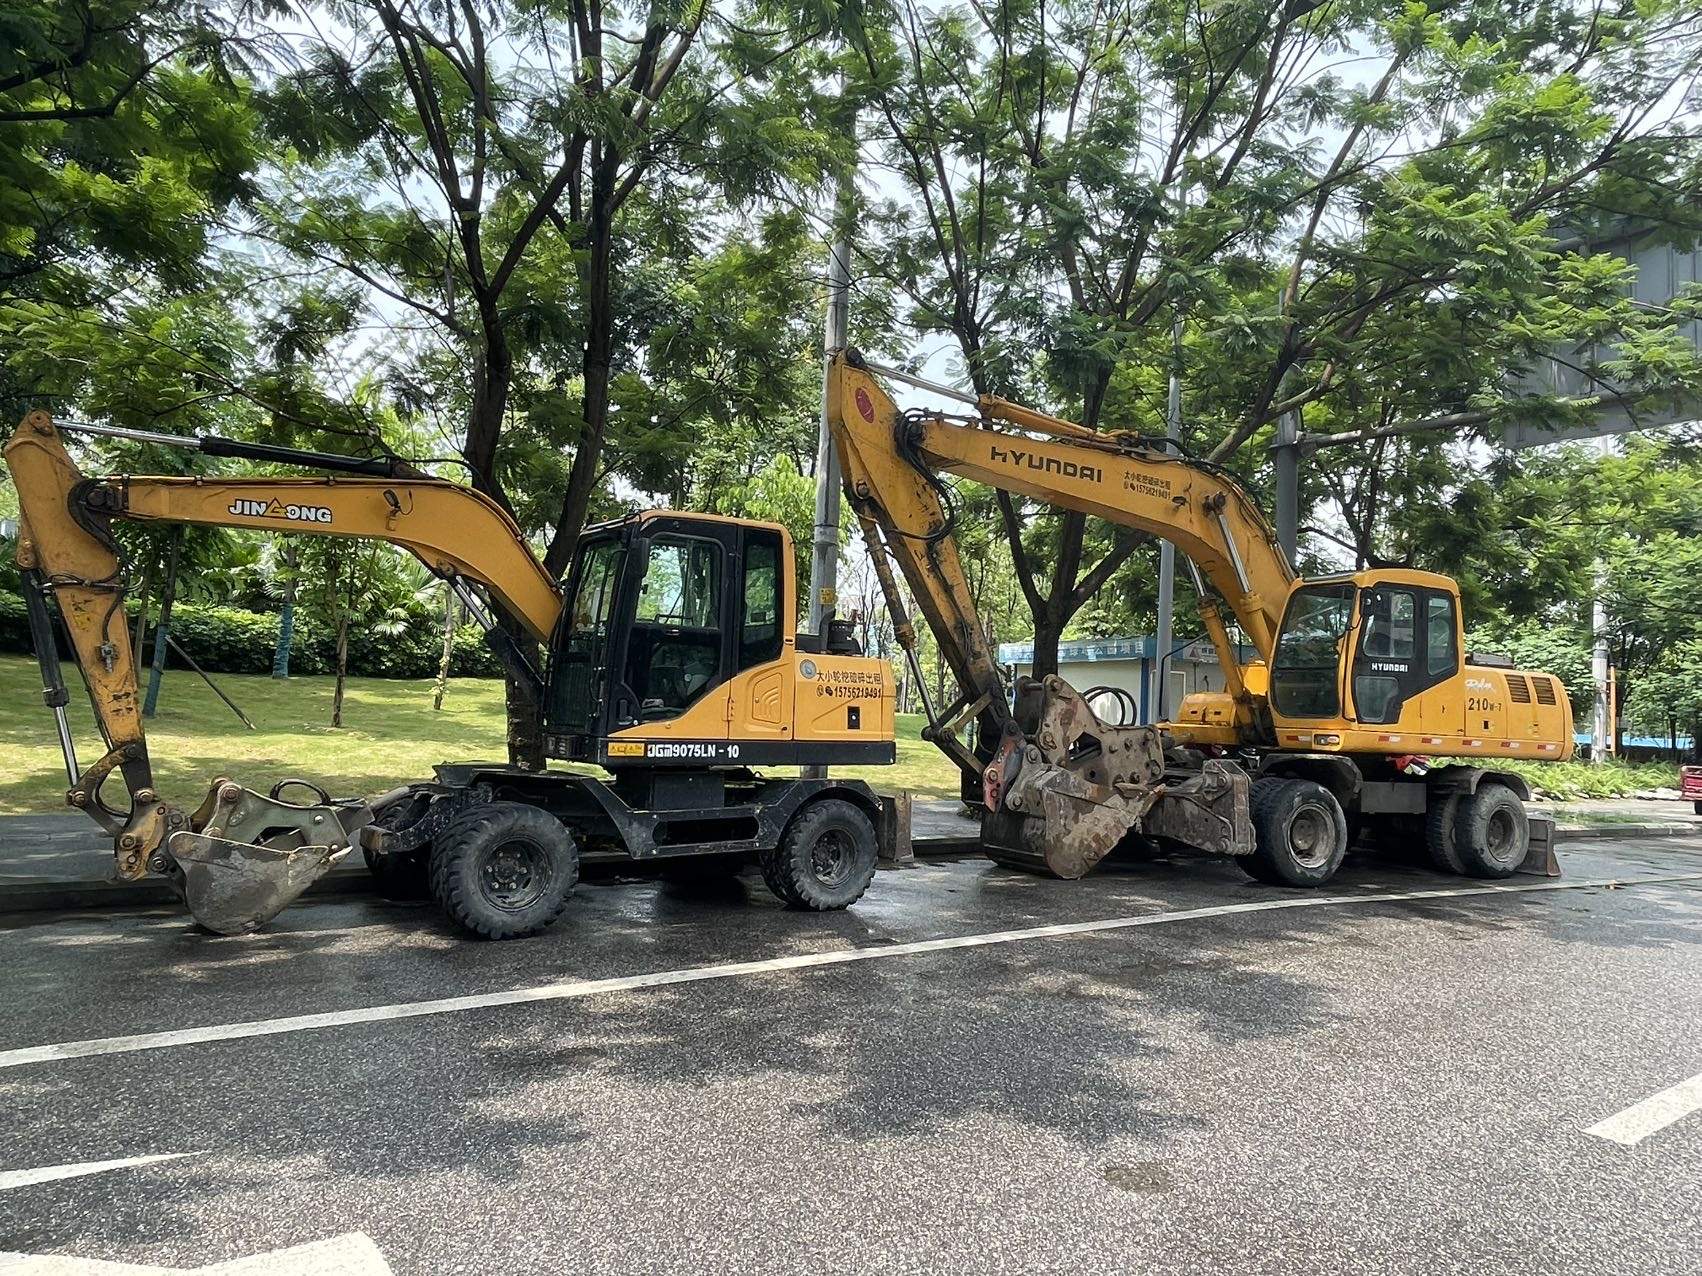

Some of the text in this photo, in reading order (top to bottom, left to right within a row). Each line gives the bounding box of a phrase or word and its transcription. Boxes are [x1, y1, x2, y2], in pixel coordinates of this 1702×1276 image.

[990, 446, 1102, 483] HYUNDAI
[1371, 662, 1409, 673] HYUNDAI
[834, 685, 881, 699] 15756219491
[727, 744, 740, 758] 10
